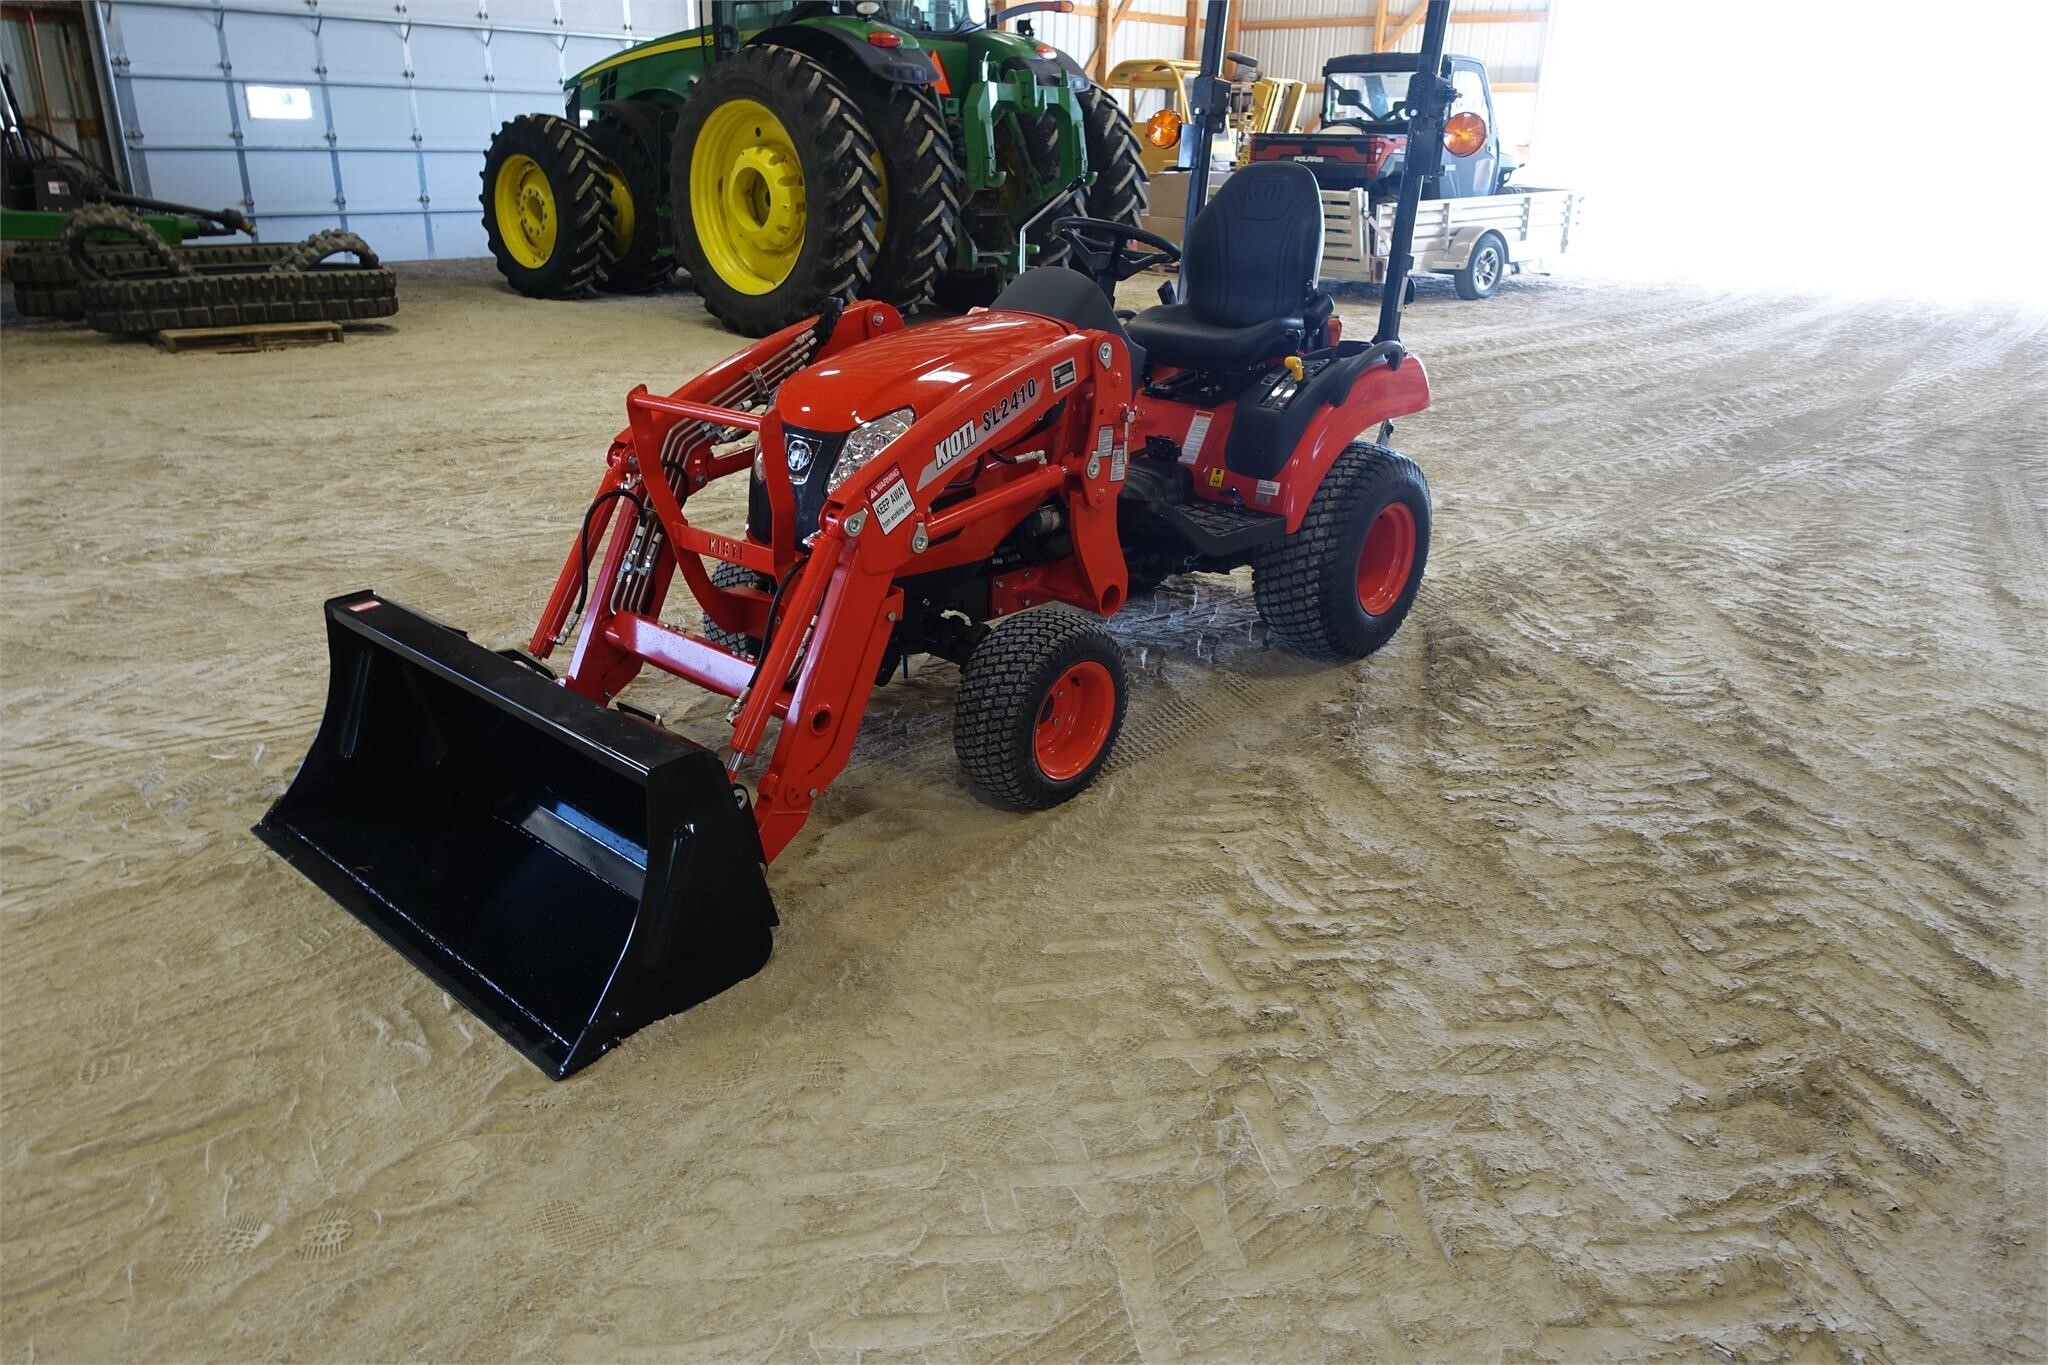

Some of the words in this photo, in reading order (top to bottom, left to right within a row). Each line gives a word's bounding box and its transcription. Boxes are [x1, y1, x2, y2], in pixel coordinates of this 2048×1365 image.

[934, 418, 977, 470] KIOTI
[982, 378, 1037, 431] SL2410
[875, 468, 900, 492] WARNING
[875, 498, 890, 517] KEEP
[889, 484, 907, 505] AWAY
[881, 516, 892, 528] from
[891, 506, 906, 521] working
[904, 499, 912, 510] area
